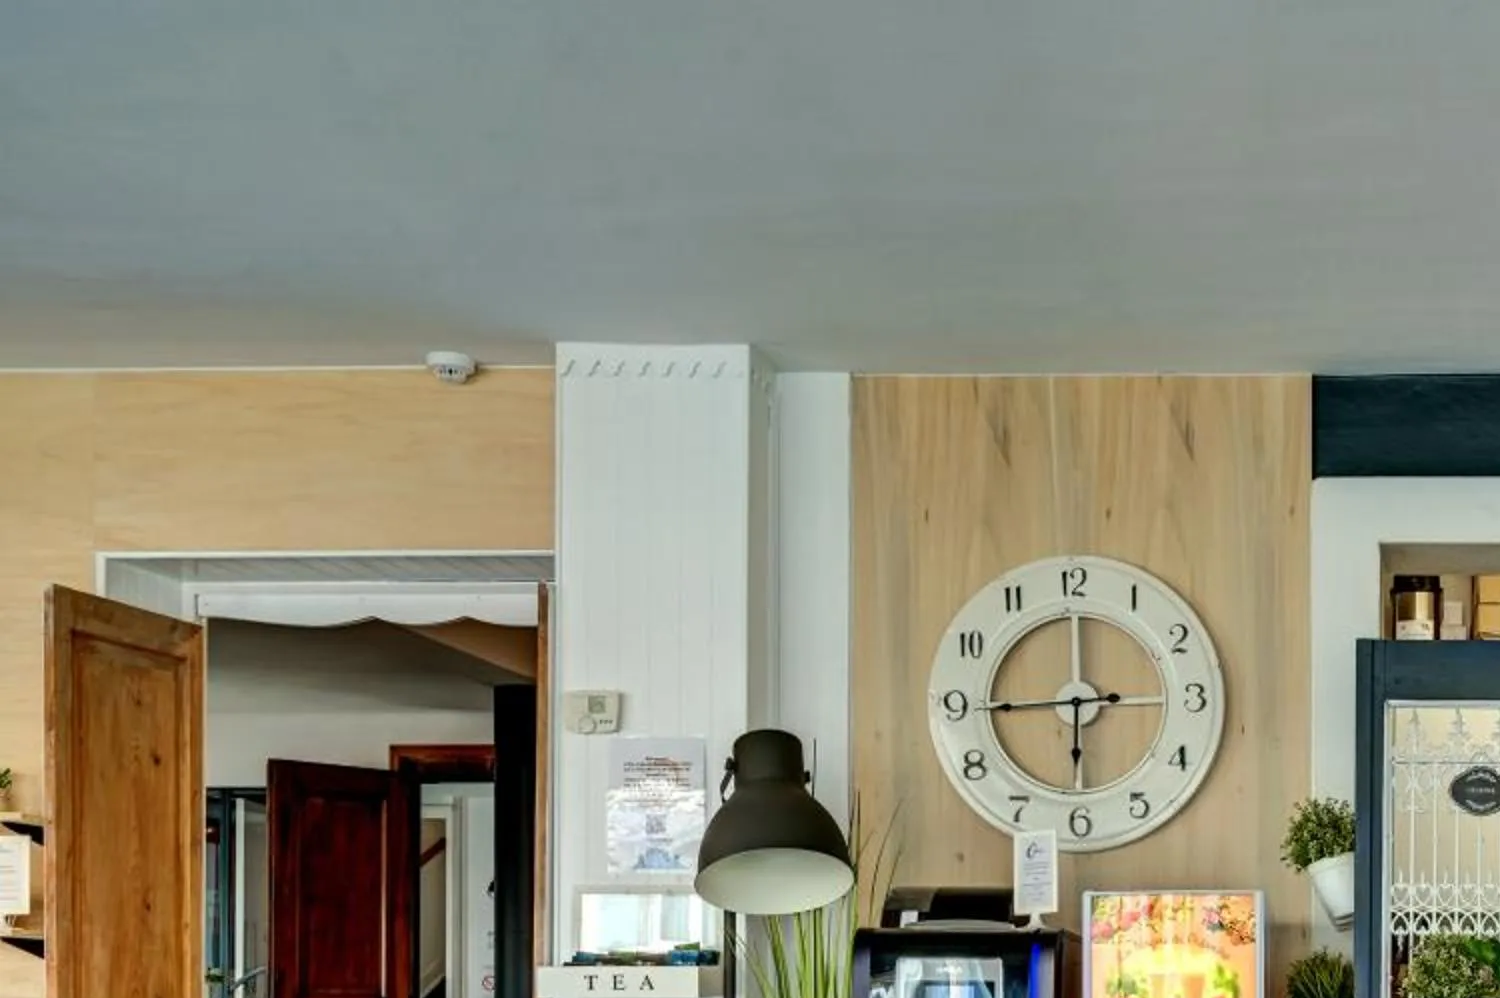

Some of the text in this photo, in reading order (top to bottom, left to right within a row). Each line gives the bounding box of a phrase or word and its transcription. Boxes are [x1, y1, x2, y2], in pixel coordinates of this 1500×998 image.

[1061, 567, 1088, 597] 12
[1004, 585, 1021, 613] 11
[1130, 583, 1137, 611] 1
[959, 630, 984, 659] 10
[1169, 623, 1190, 654] 2
[943, 690, 968, 721] 9
[1183, 683, 1207, 713] 3
[963, 749, 987, 780] 8
[1168, 745, 1188, 771] 4
[1008, 795, 1031, 823] 7
[1129, 792, 1150, 819] 5
[1068, 807, 1092, 838] 6
[583, 974, 655, 991] TEA
